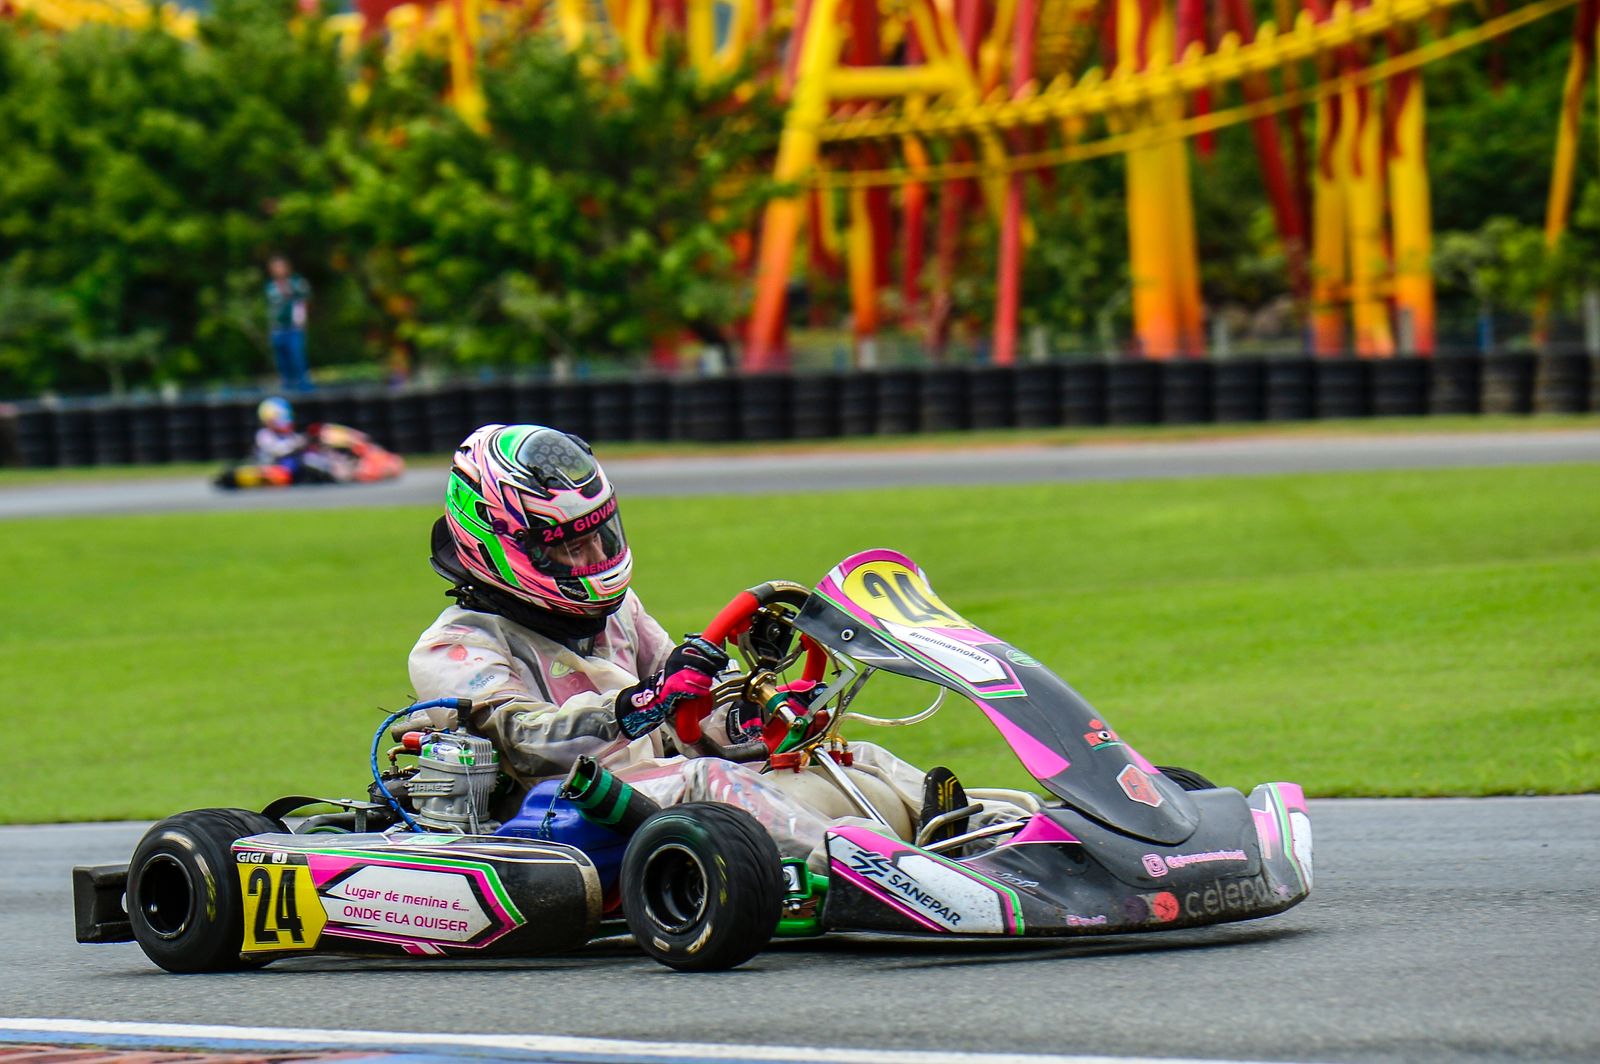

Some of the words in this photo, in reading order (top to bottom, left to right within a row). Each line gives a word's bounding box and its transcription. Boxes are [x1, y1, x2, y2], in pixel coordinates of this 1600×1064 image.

[543, 526, 564, 542] 24
[863, 569, 959, 623] 24
[909, 632, 989, 664] #meninasnokart
[236, 851, 266, 863] GIGI
[247, 865, 305, 944] 24
[345, 883, 381, 900] Lugar
[384, 890, 399, 902] de
[402, 895, 448, 910] menina
[889, 873, 962, 927] SANEPAR
[343, 905, 381, 921] ONDE
[385, 911, 410, 926] ELA
[413, 916, 468, 932] QUISER
